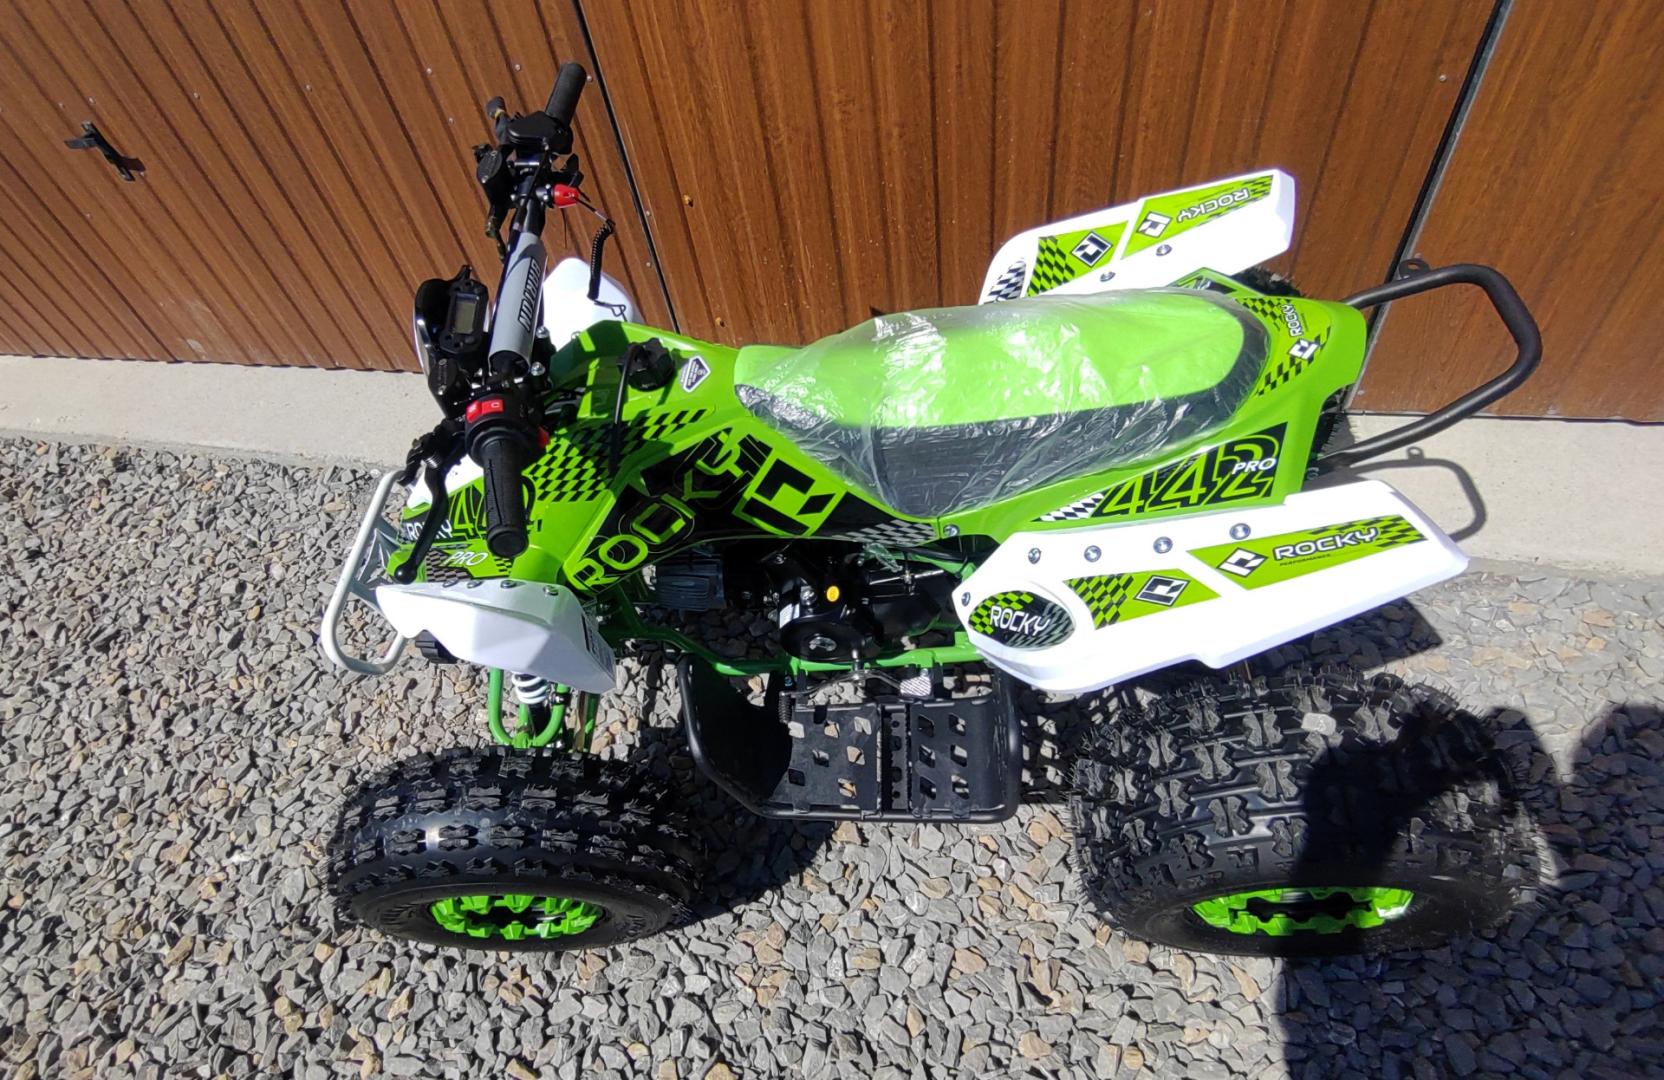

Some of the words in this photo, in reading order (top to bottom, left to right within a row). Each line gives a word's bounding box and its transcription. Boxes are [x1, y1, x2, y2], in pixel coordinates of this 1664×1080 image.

[1176, 187, 1250, 223] ROCKY
[518, 258, 541, 331] BARTON
[1282, 302, 1304, 336] ROCKY
[1100, 438, 1274, 517] 442
[1231, 458, 1277, 475] PRO
[563, 424, 745, 590] ROCKY
[406, 519, 453, 541] ROY
[1273, 525, 1380, 562] ROCKY
[441, 551, 489, 566] PRO
[989, 604, 1052, 637] ROCKY
